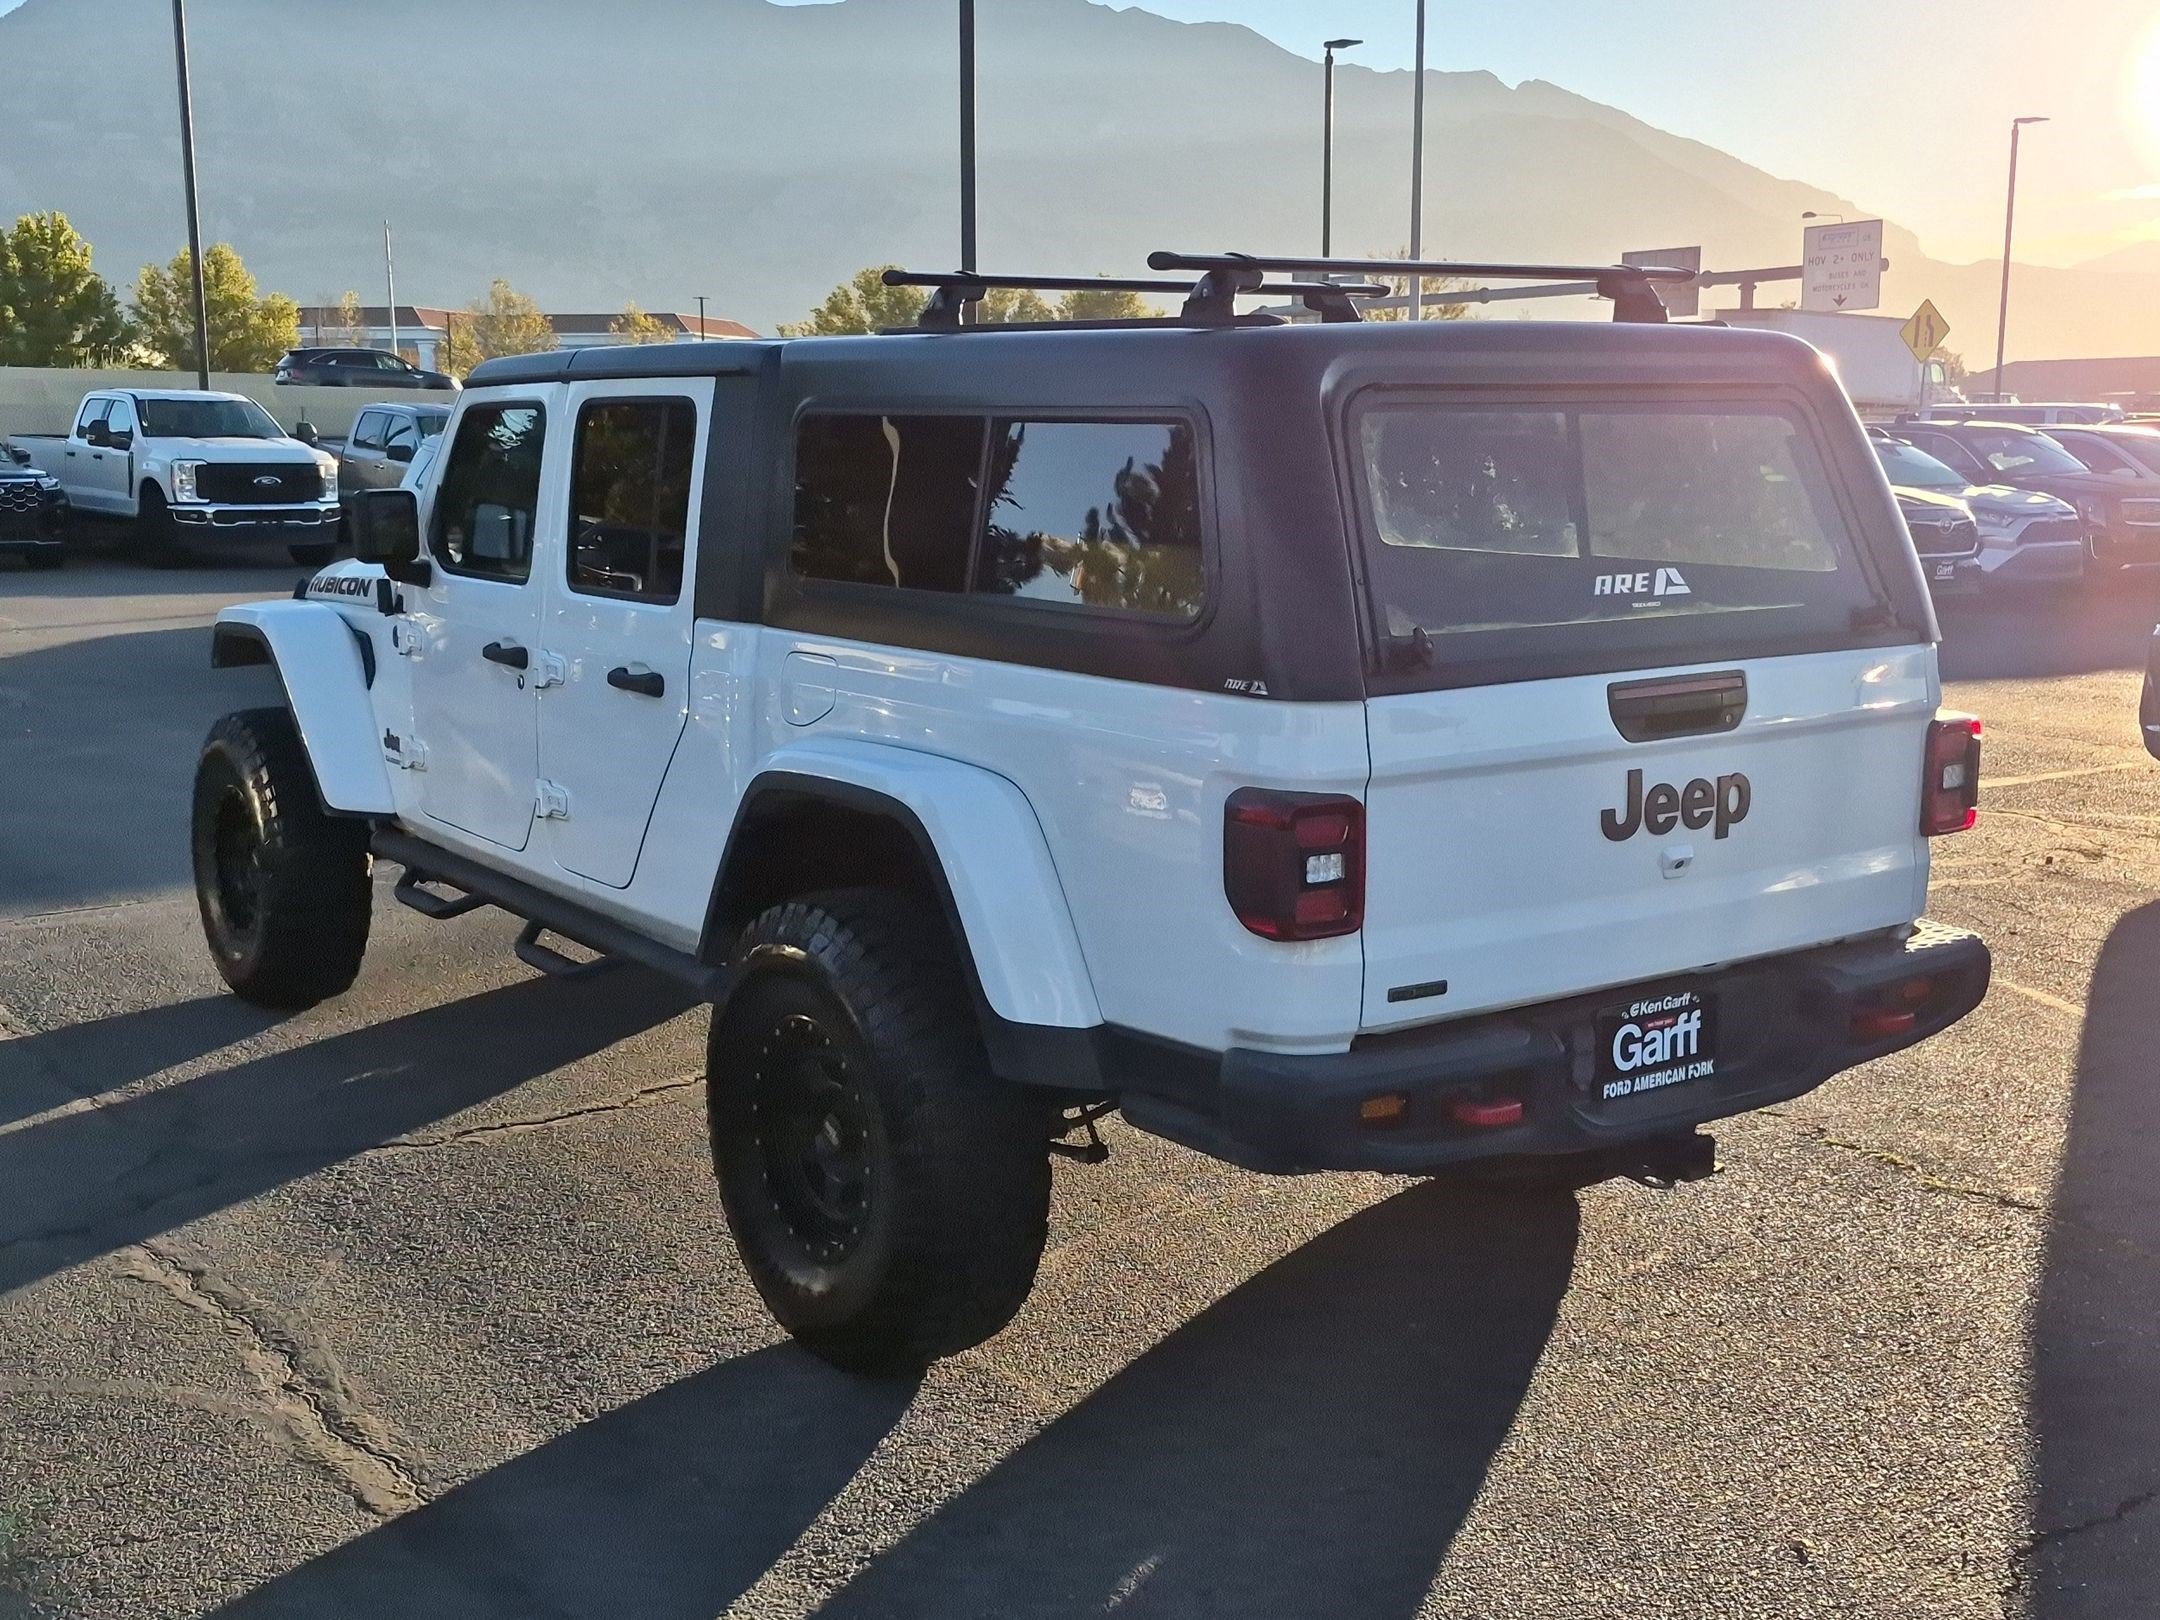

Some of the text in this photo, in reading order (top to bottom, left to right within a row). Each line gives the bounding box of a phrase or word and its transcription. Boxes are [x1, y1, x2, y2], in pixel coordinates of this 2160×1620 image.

[1808, 252, 1875, 266] HOV 2+ ONLY
[309, 575, 372, 597] RUBICON
[1594, 572, 1650, 595] ARE
[1601, 768, 1751, 842] Jeep
[1640, 992, 1691, 1015] Ken Garff
[1612, 1009, 1702, 1071] Garff
[1603, 1059, 1714, 1099] FORD AMERICAN FORK
